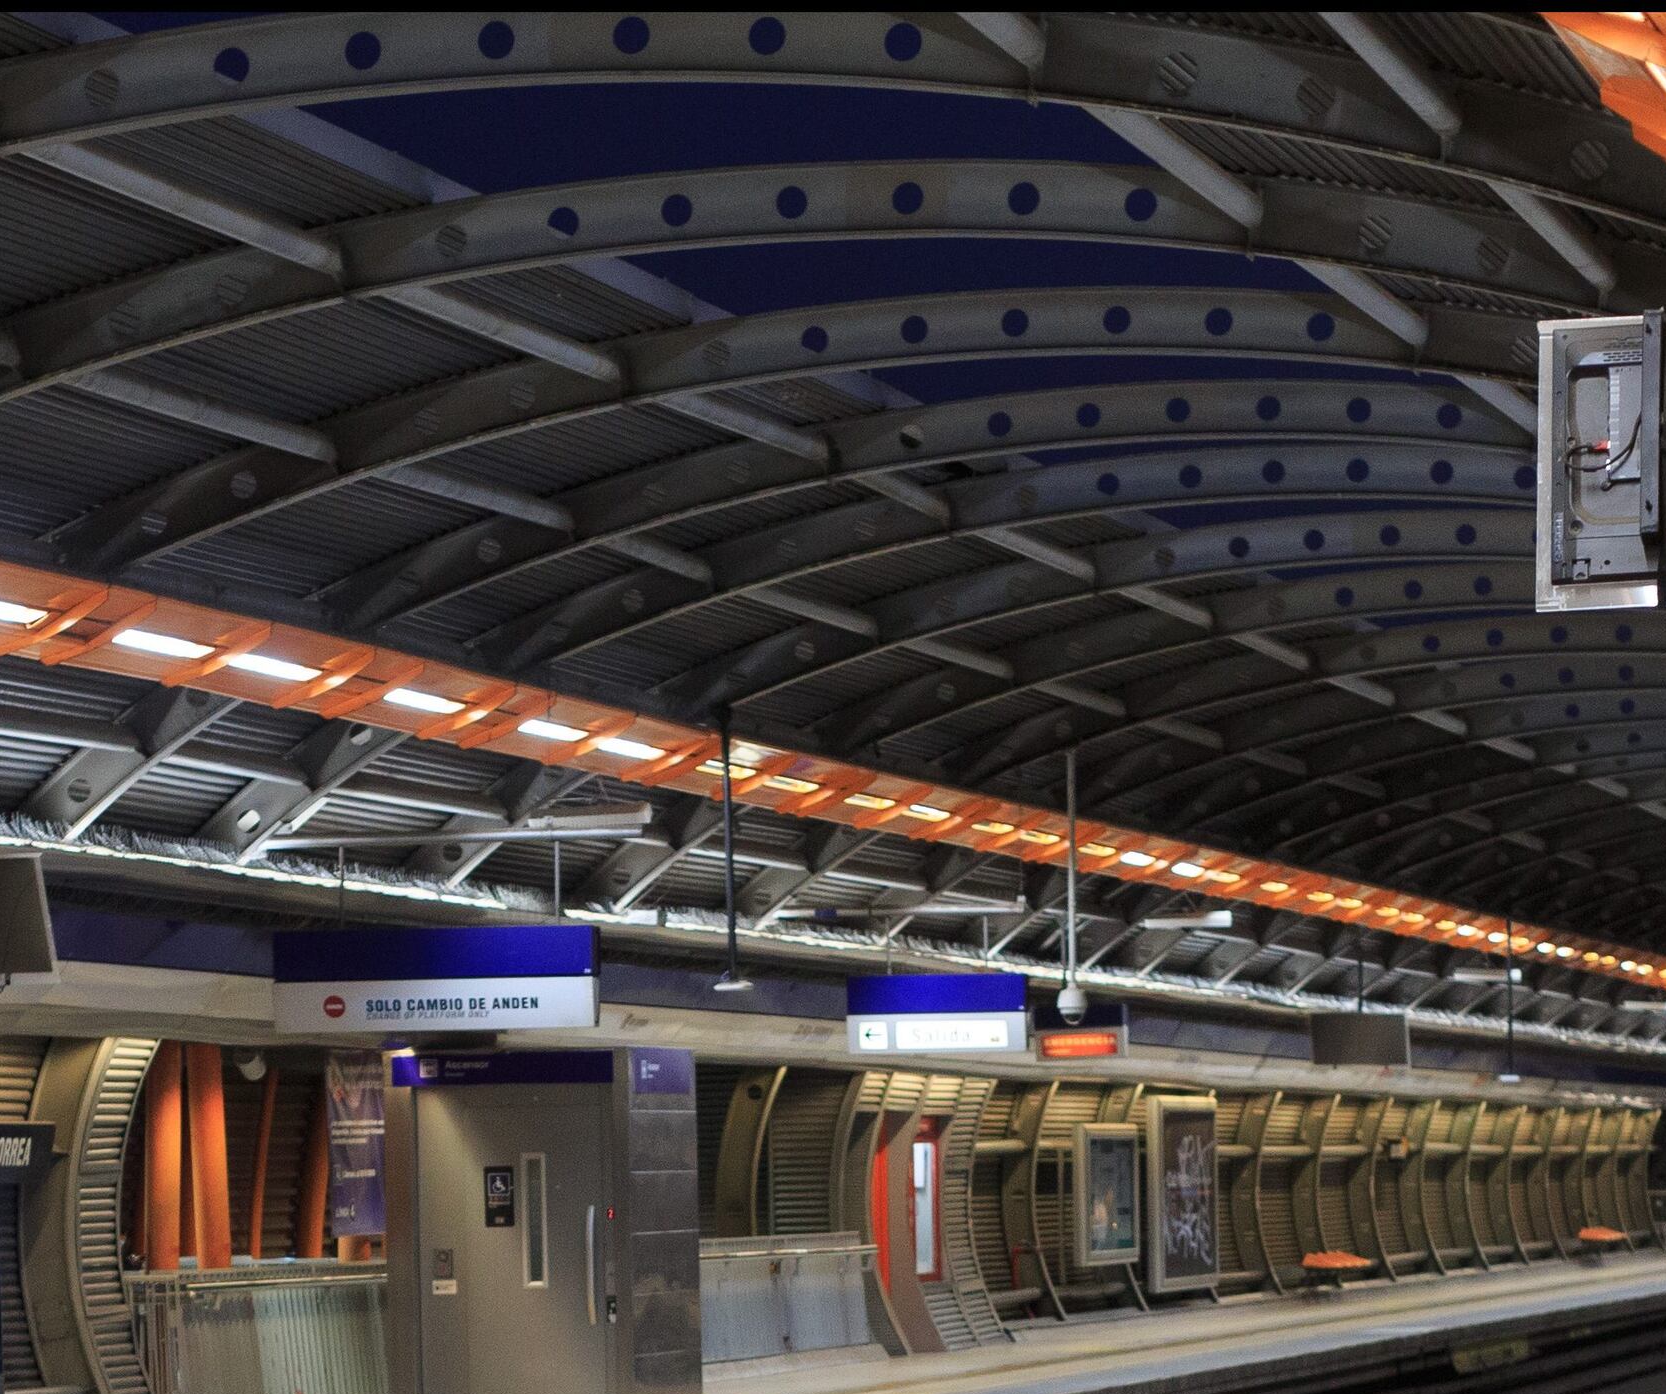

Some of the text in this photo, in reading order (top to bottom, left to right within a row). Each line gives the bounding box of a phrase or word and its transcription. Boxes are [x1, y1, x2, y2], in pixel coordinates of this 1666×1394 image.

[366, 996, 539, 1013] SOLO CAMBIO DE ANDEN
[911, 1025, 973, 1043] Salida
